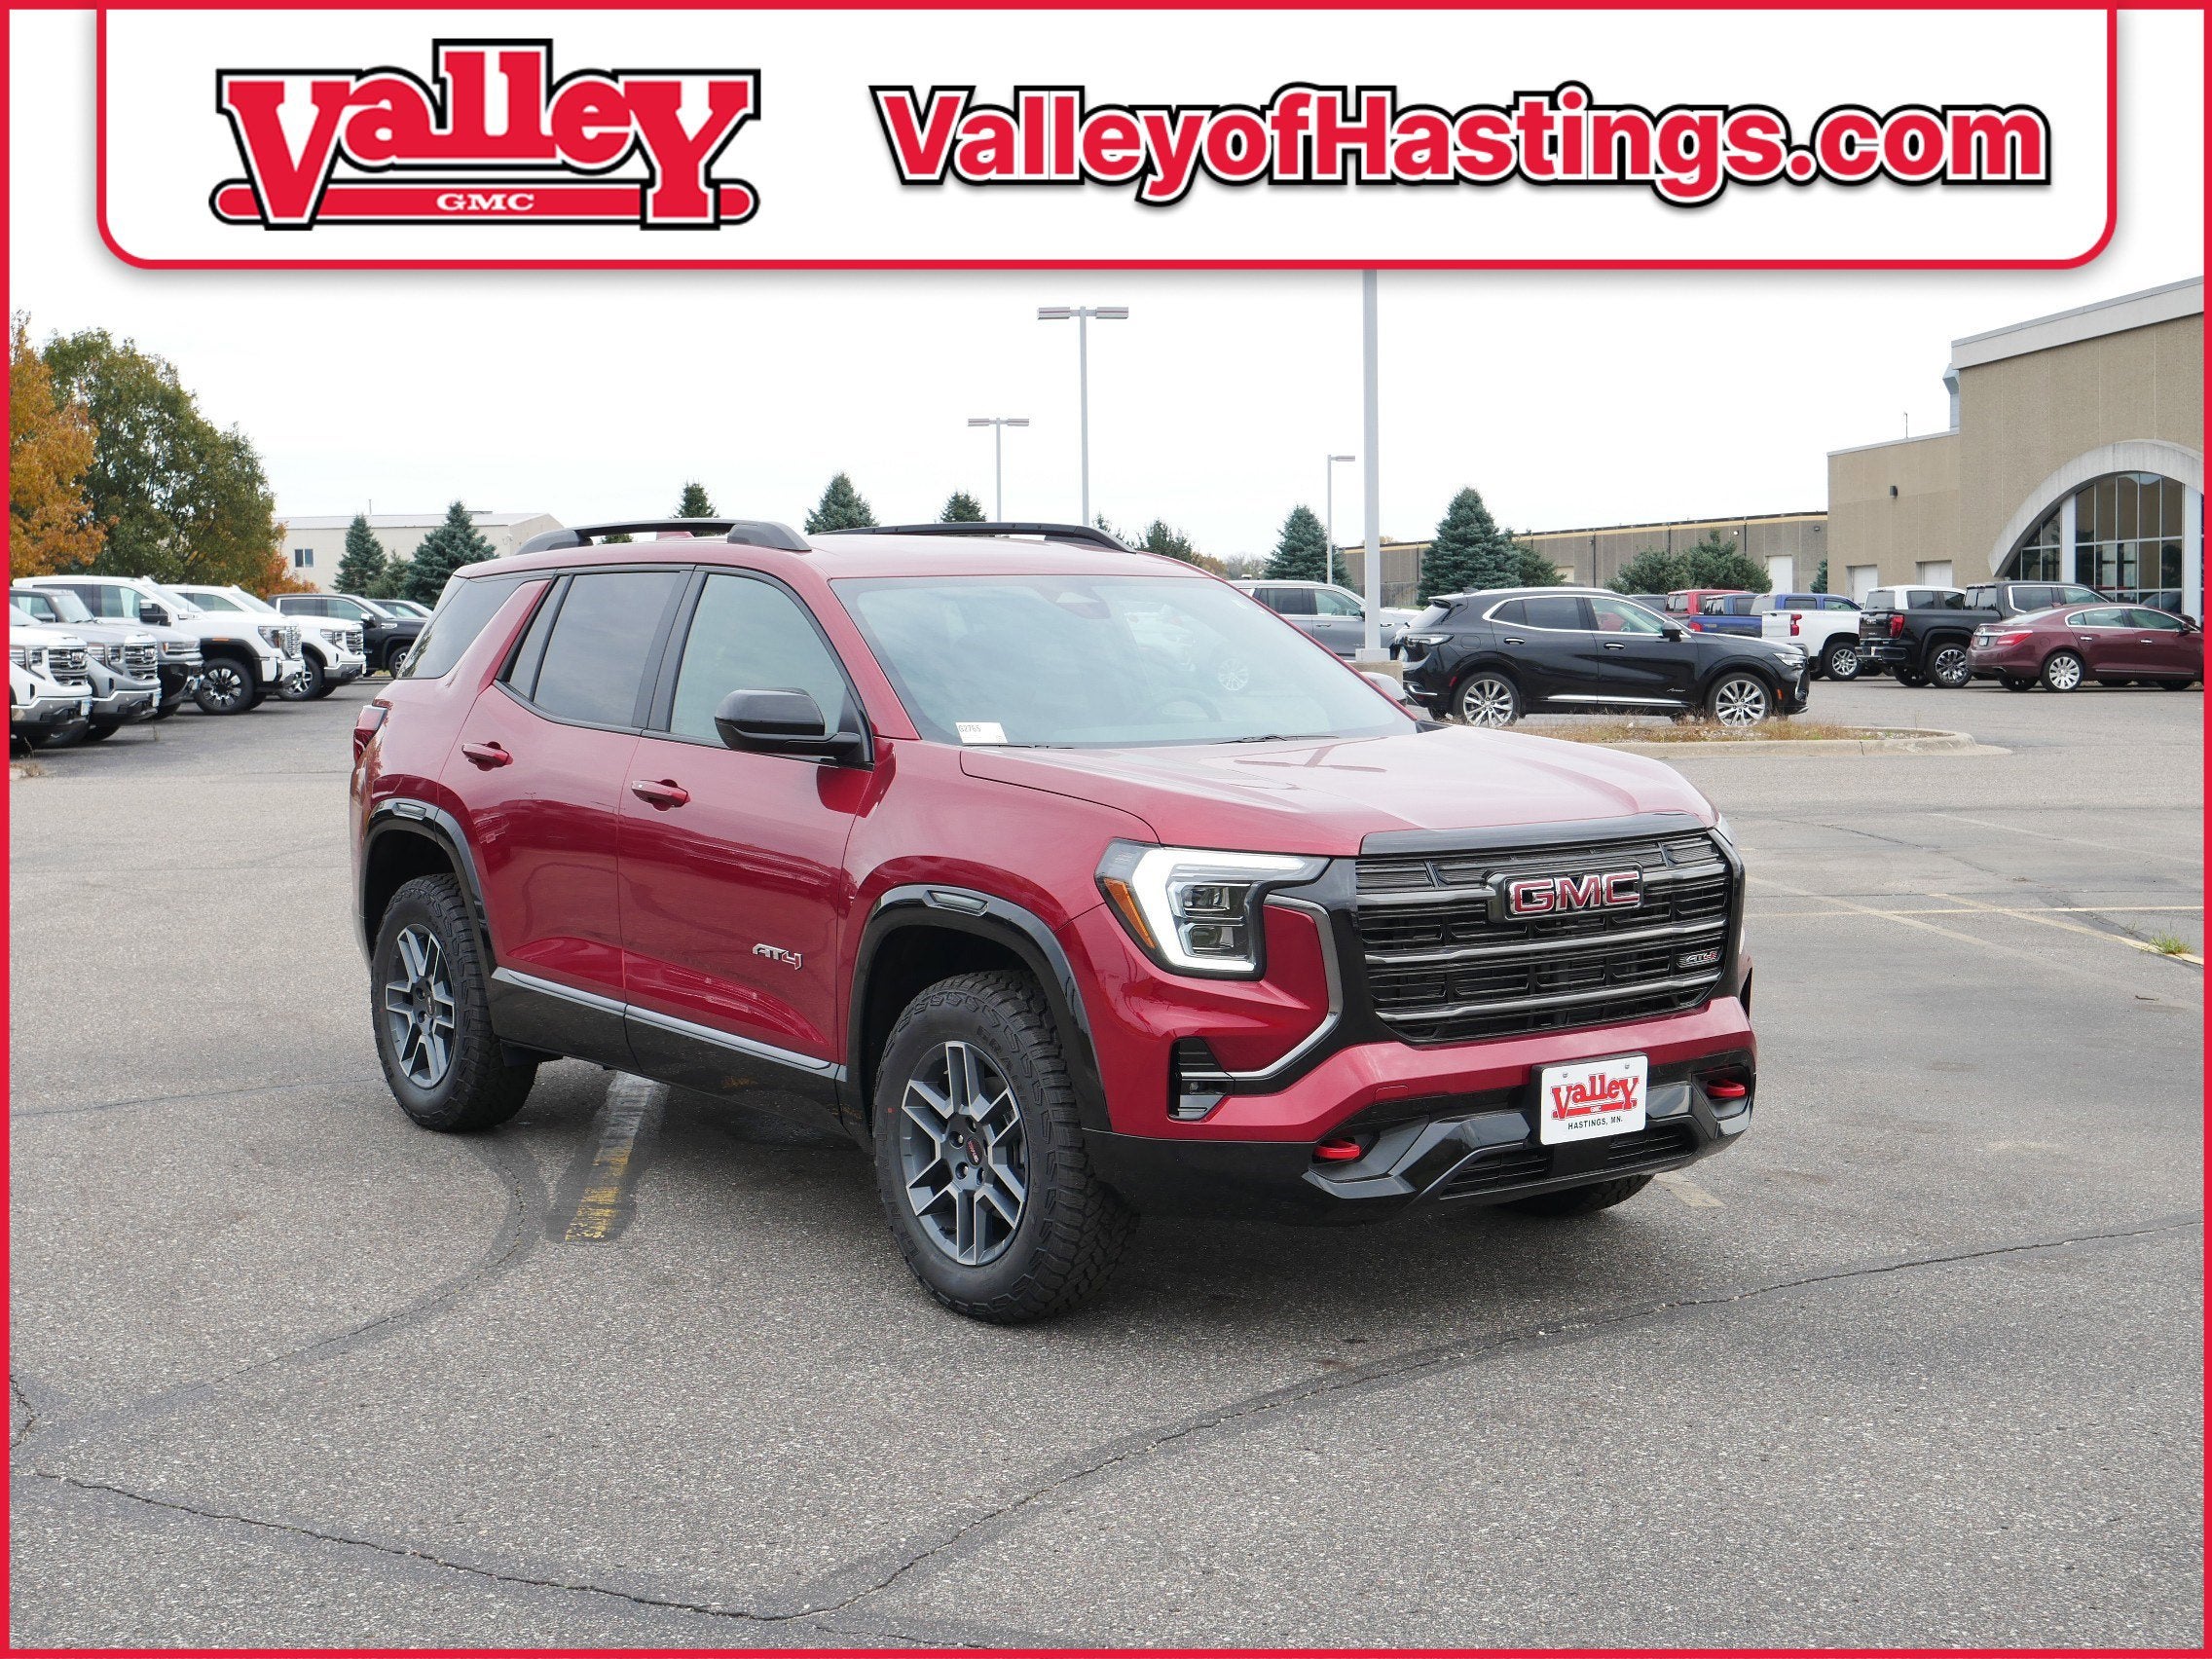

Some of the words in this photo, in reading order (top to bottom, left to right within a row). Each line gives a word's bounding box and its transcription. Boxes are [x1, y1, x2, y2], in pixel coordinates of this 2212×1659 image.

[1510, 870, 1641, 915] GMC
[753, 942, 802, 970] AT4
[1550, 1073, 1640, 1121] Valley
[1567, 1118, 1608, 1130] HASTINGS,
